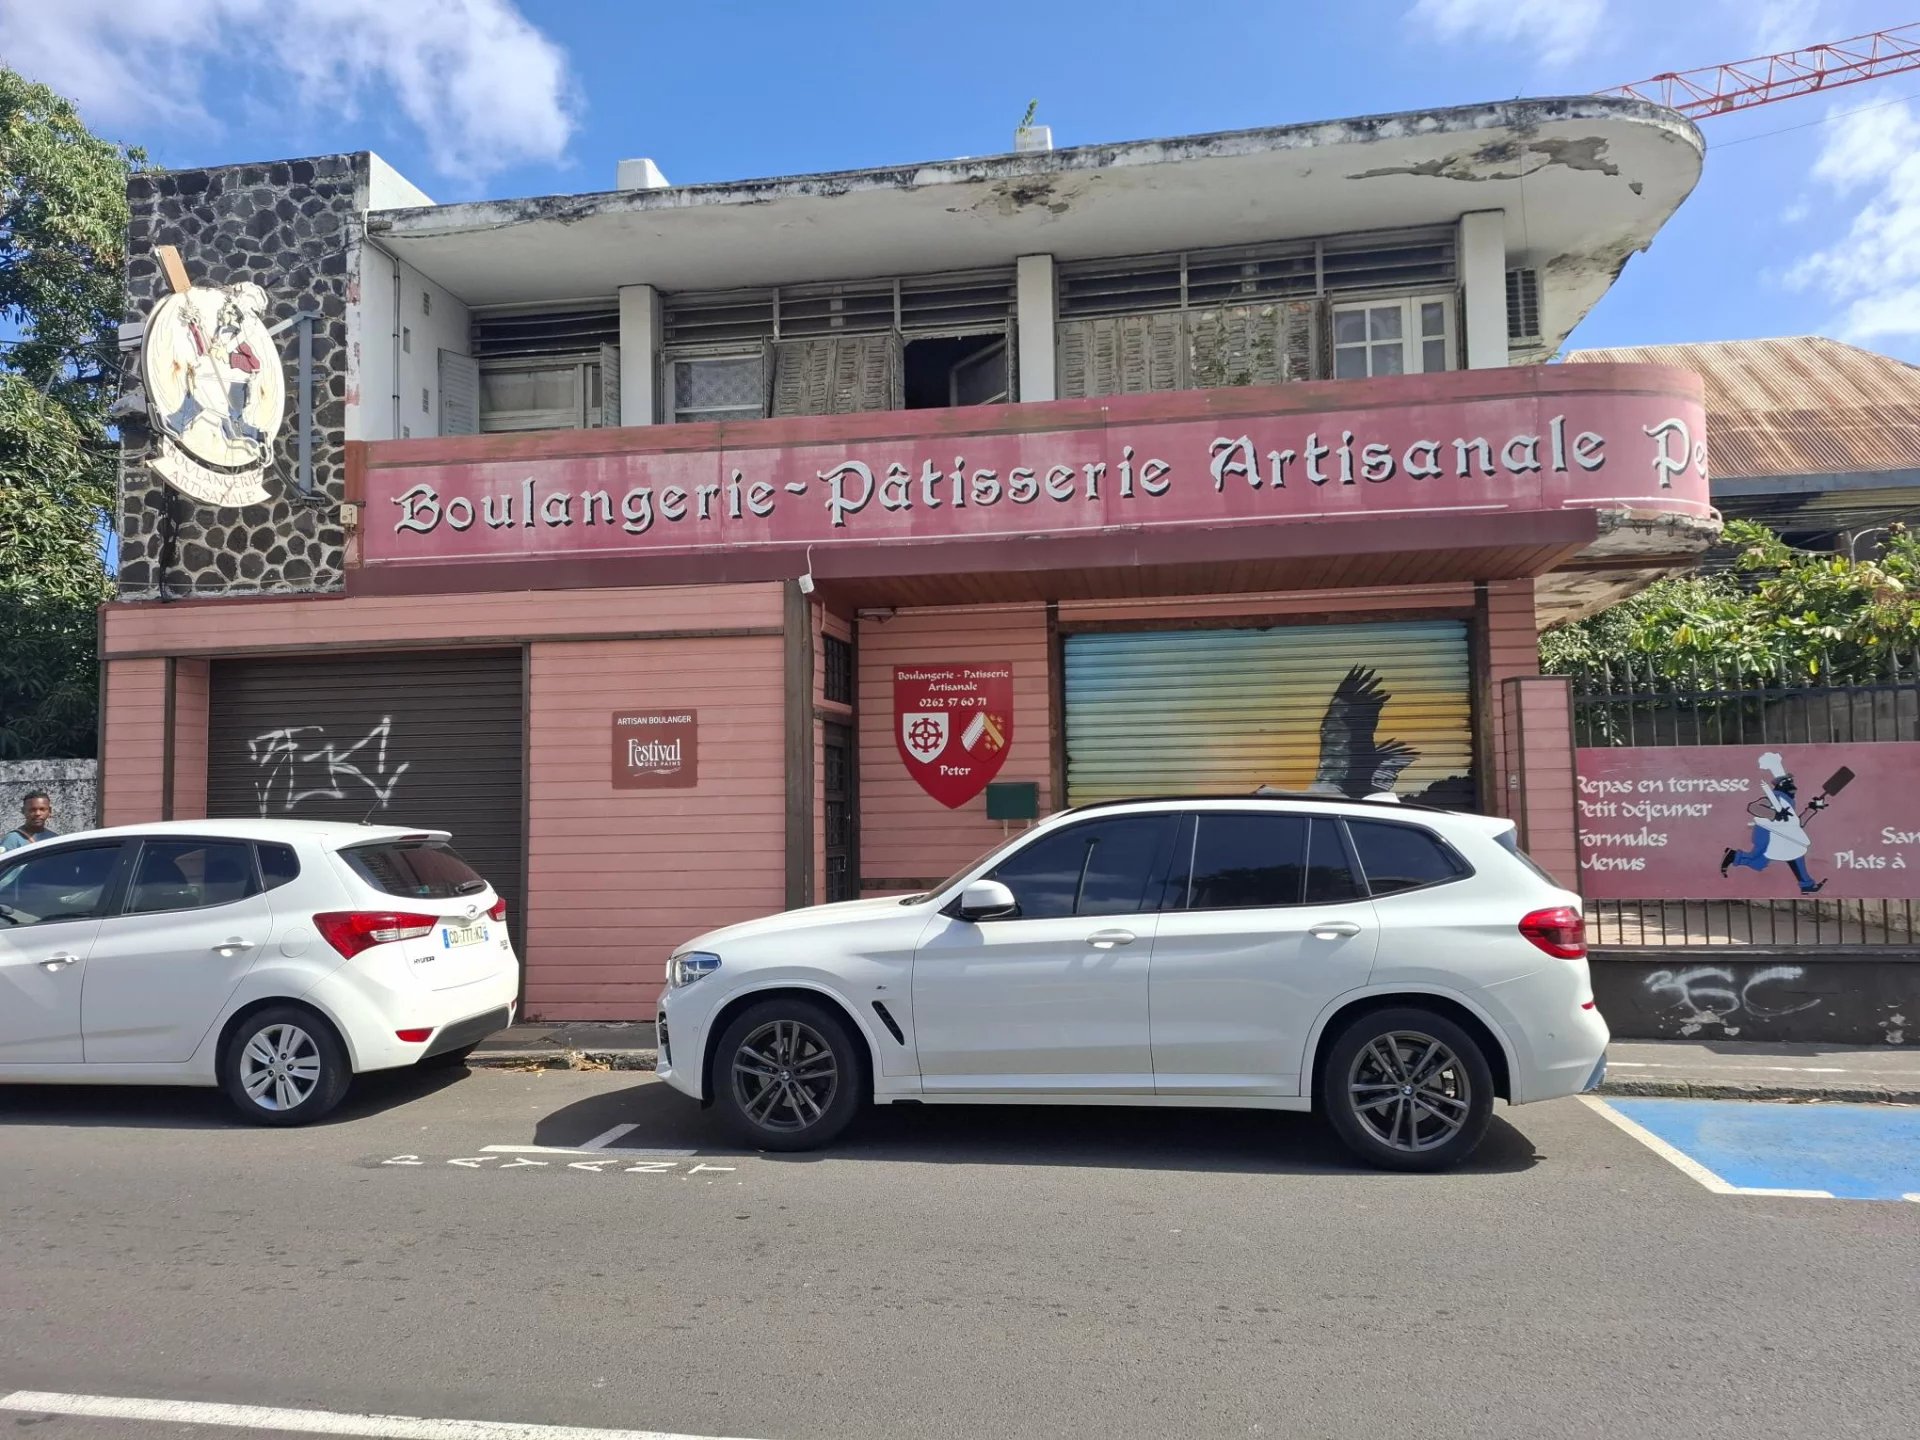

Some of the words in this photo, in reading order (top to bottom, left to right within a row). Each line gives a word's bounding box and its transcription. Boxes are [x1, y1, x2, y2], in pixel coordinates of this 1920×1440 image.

[1208, 414, 1609, 493] Artisanale
[898, 671, 953, 682] Boulangerie
[964, 670, 1008, 678] Patisserie
[928, 682, 977, 691] Artisanale
[919, 697, 944, 707] 0262
[947, 697, 958, 707] 57
[960, 697, 974, 706] 60
[977, 696, 987, 706] 71
[617, 717, 647, 725] ARTISAN
[649, 716, 691, 724] BOULANGER
[628, 739, 681, 767] Festival
[940, 765, 971, 776] Peter
[1637, 779, 1664, 793] en
[1667, 777, 1750, 793] terrasse
[1621, 800, 1713, 822] déjeuner
[1834, 849, 1887, 869] Plats
[1891, 853, 1906, 869] à
[381, 1154, 737, 1174] PAYANT
